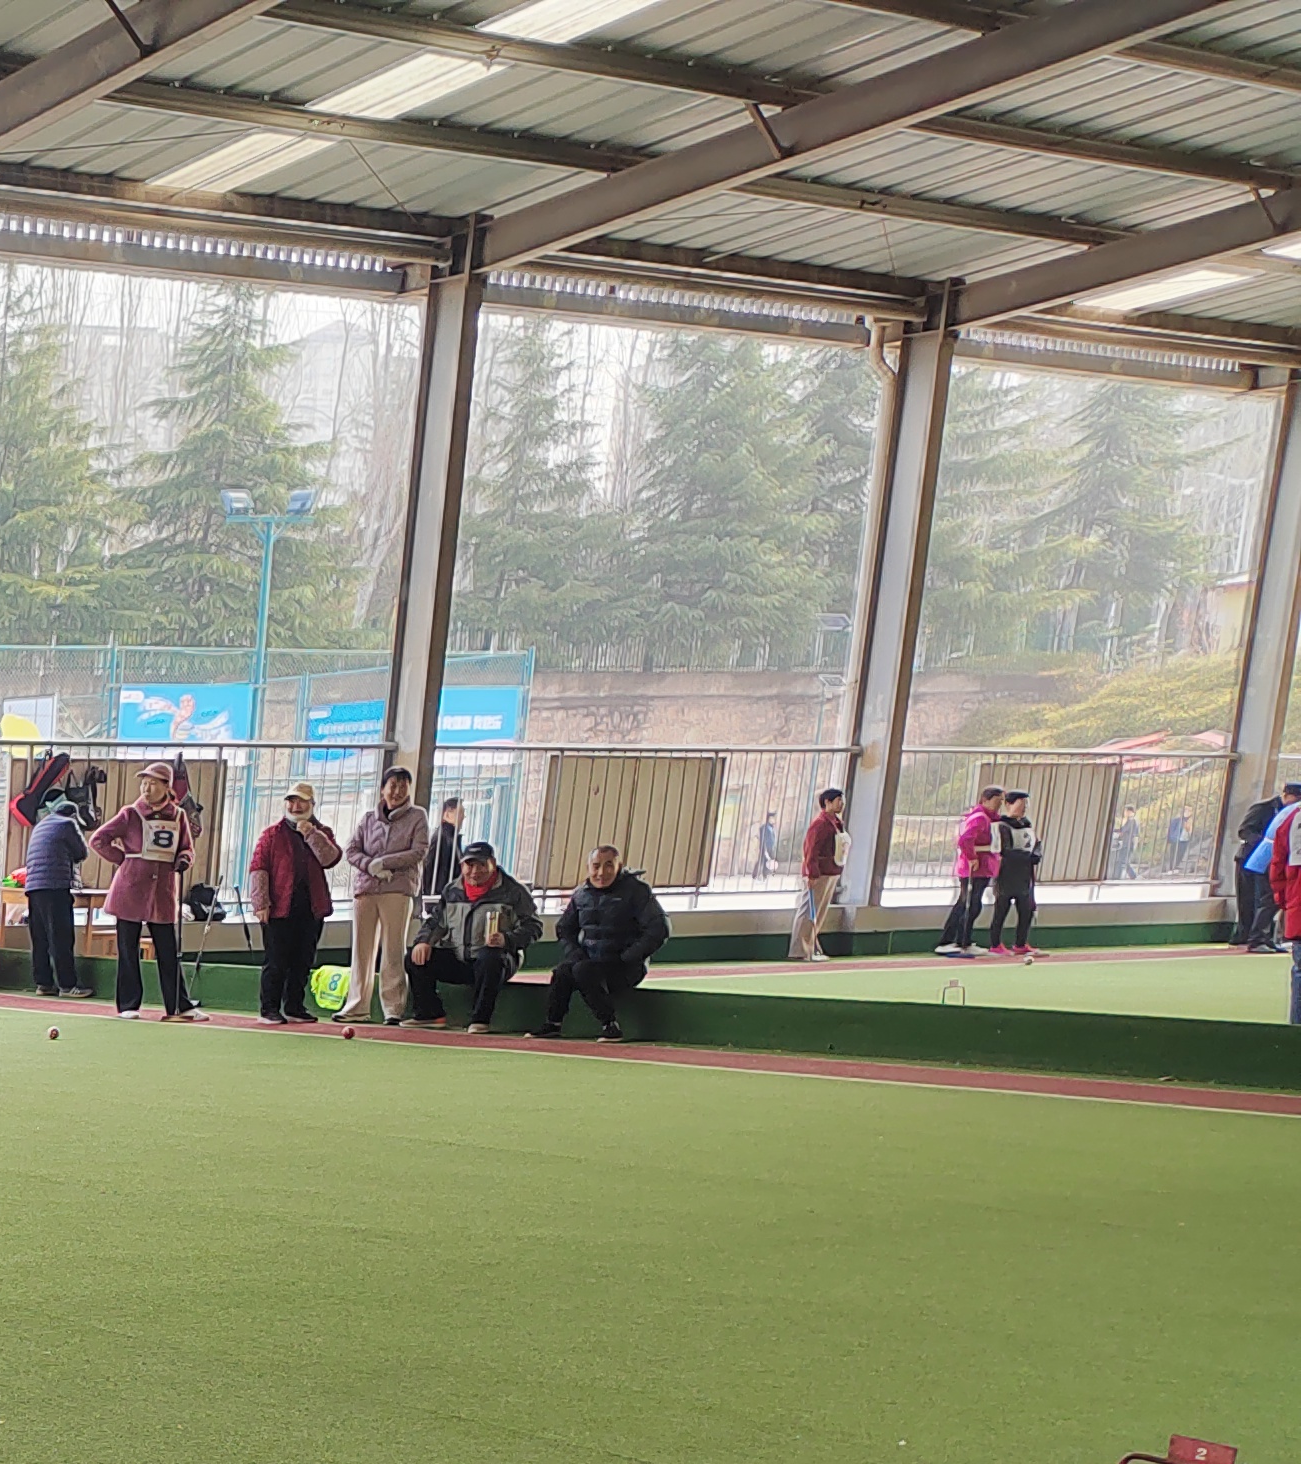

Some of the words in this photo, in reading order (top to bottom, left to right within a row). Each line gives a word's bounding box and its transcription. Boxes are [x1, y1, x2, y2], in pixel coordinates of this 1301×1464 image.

[153, 830, 174, 848] 8
[329, 973, 342, 991] 8
[1195, 1447, 1208, 1460] 2
